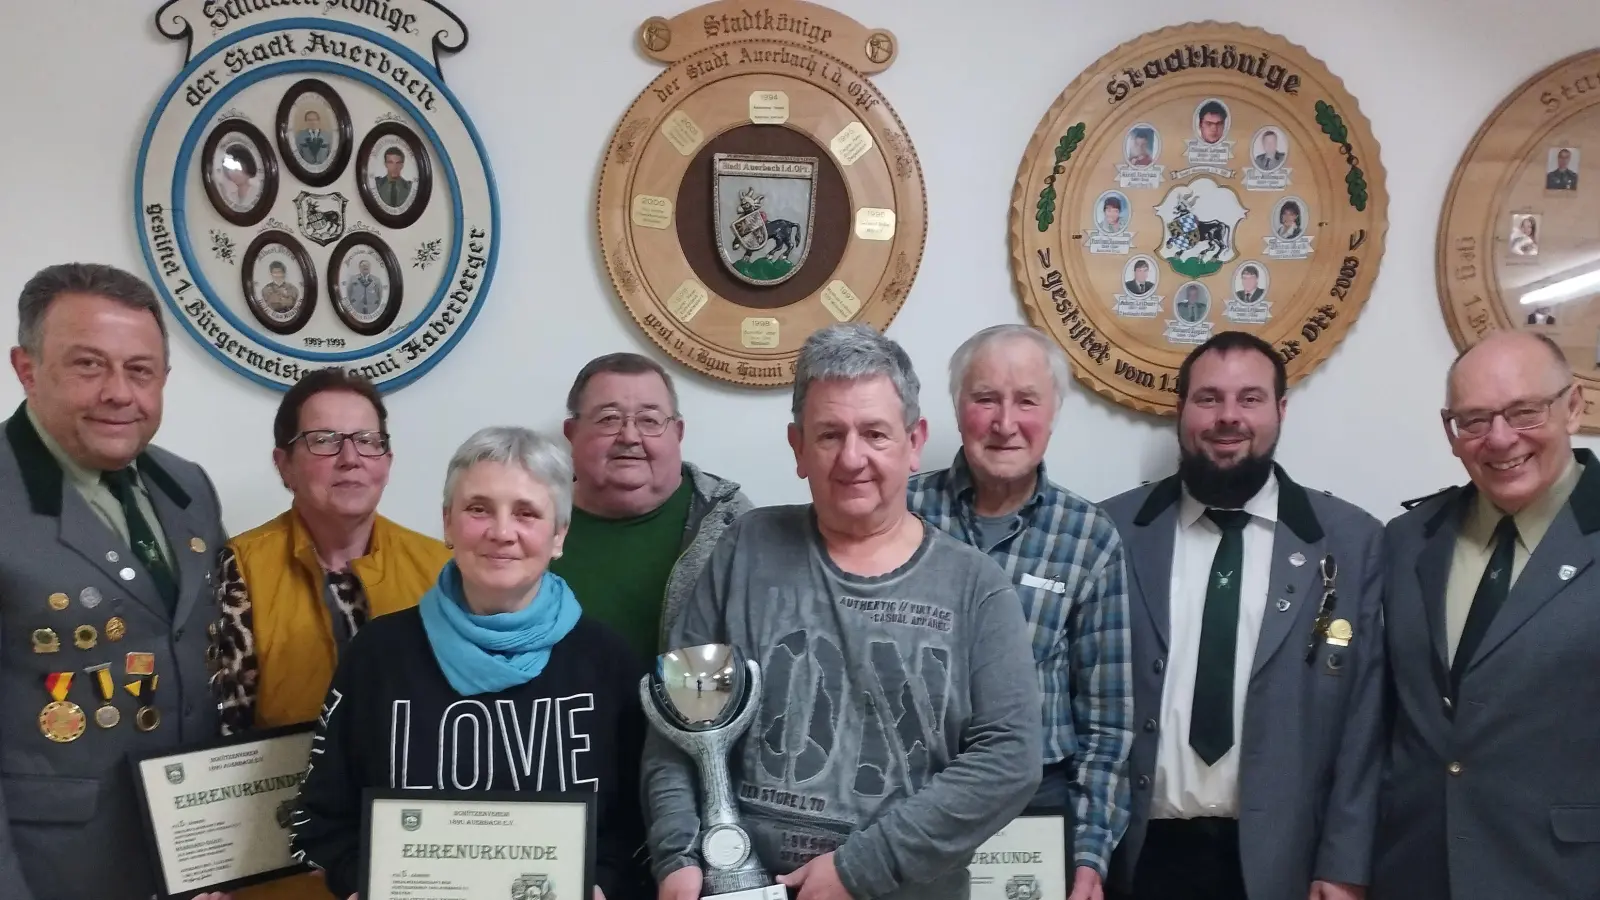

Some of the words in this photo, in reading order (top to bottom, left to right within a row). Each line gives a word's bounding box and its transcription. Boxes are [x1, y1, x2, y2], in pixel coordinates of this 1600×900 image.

[703, 9, 833, 44] Stadtkönige
[186, 69, 220, 107] der
[224, 33, 297, 74] Stadt
[301, 31, 436, 111] Auerbach
[652, 78, 681, 103] der
[686, 50, 730, 80] Stadt
[739, 47, 818, 77] Auerbach
[1106, 44, 1301, 105] Stadtkönige
[1540, 72, 1600, 113] Sta
[743, 163, 782, 172] Auerbach
[146, 203, 181, 277] gestiftet
[184, 298, 312, 382] Bürgermeiste
[396, 224, 486, 363] Haberberger
[1330, 255, 1360, 301] 2003
[1114, 358, 1156, 389] vom
[840, 596, 897, 612] AUTHENTIC
[390, 692, 600, 793] LOVE
[402, 843, 558, 861] EHRENURKUNDE
[971, 851, 1043, 865] URKUNDE
